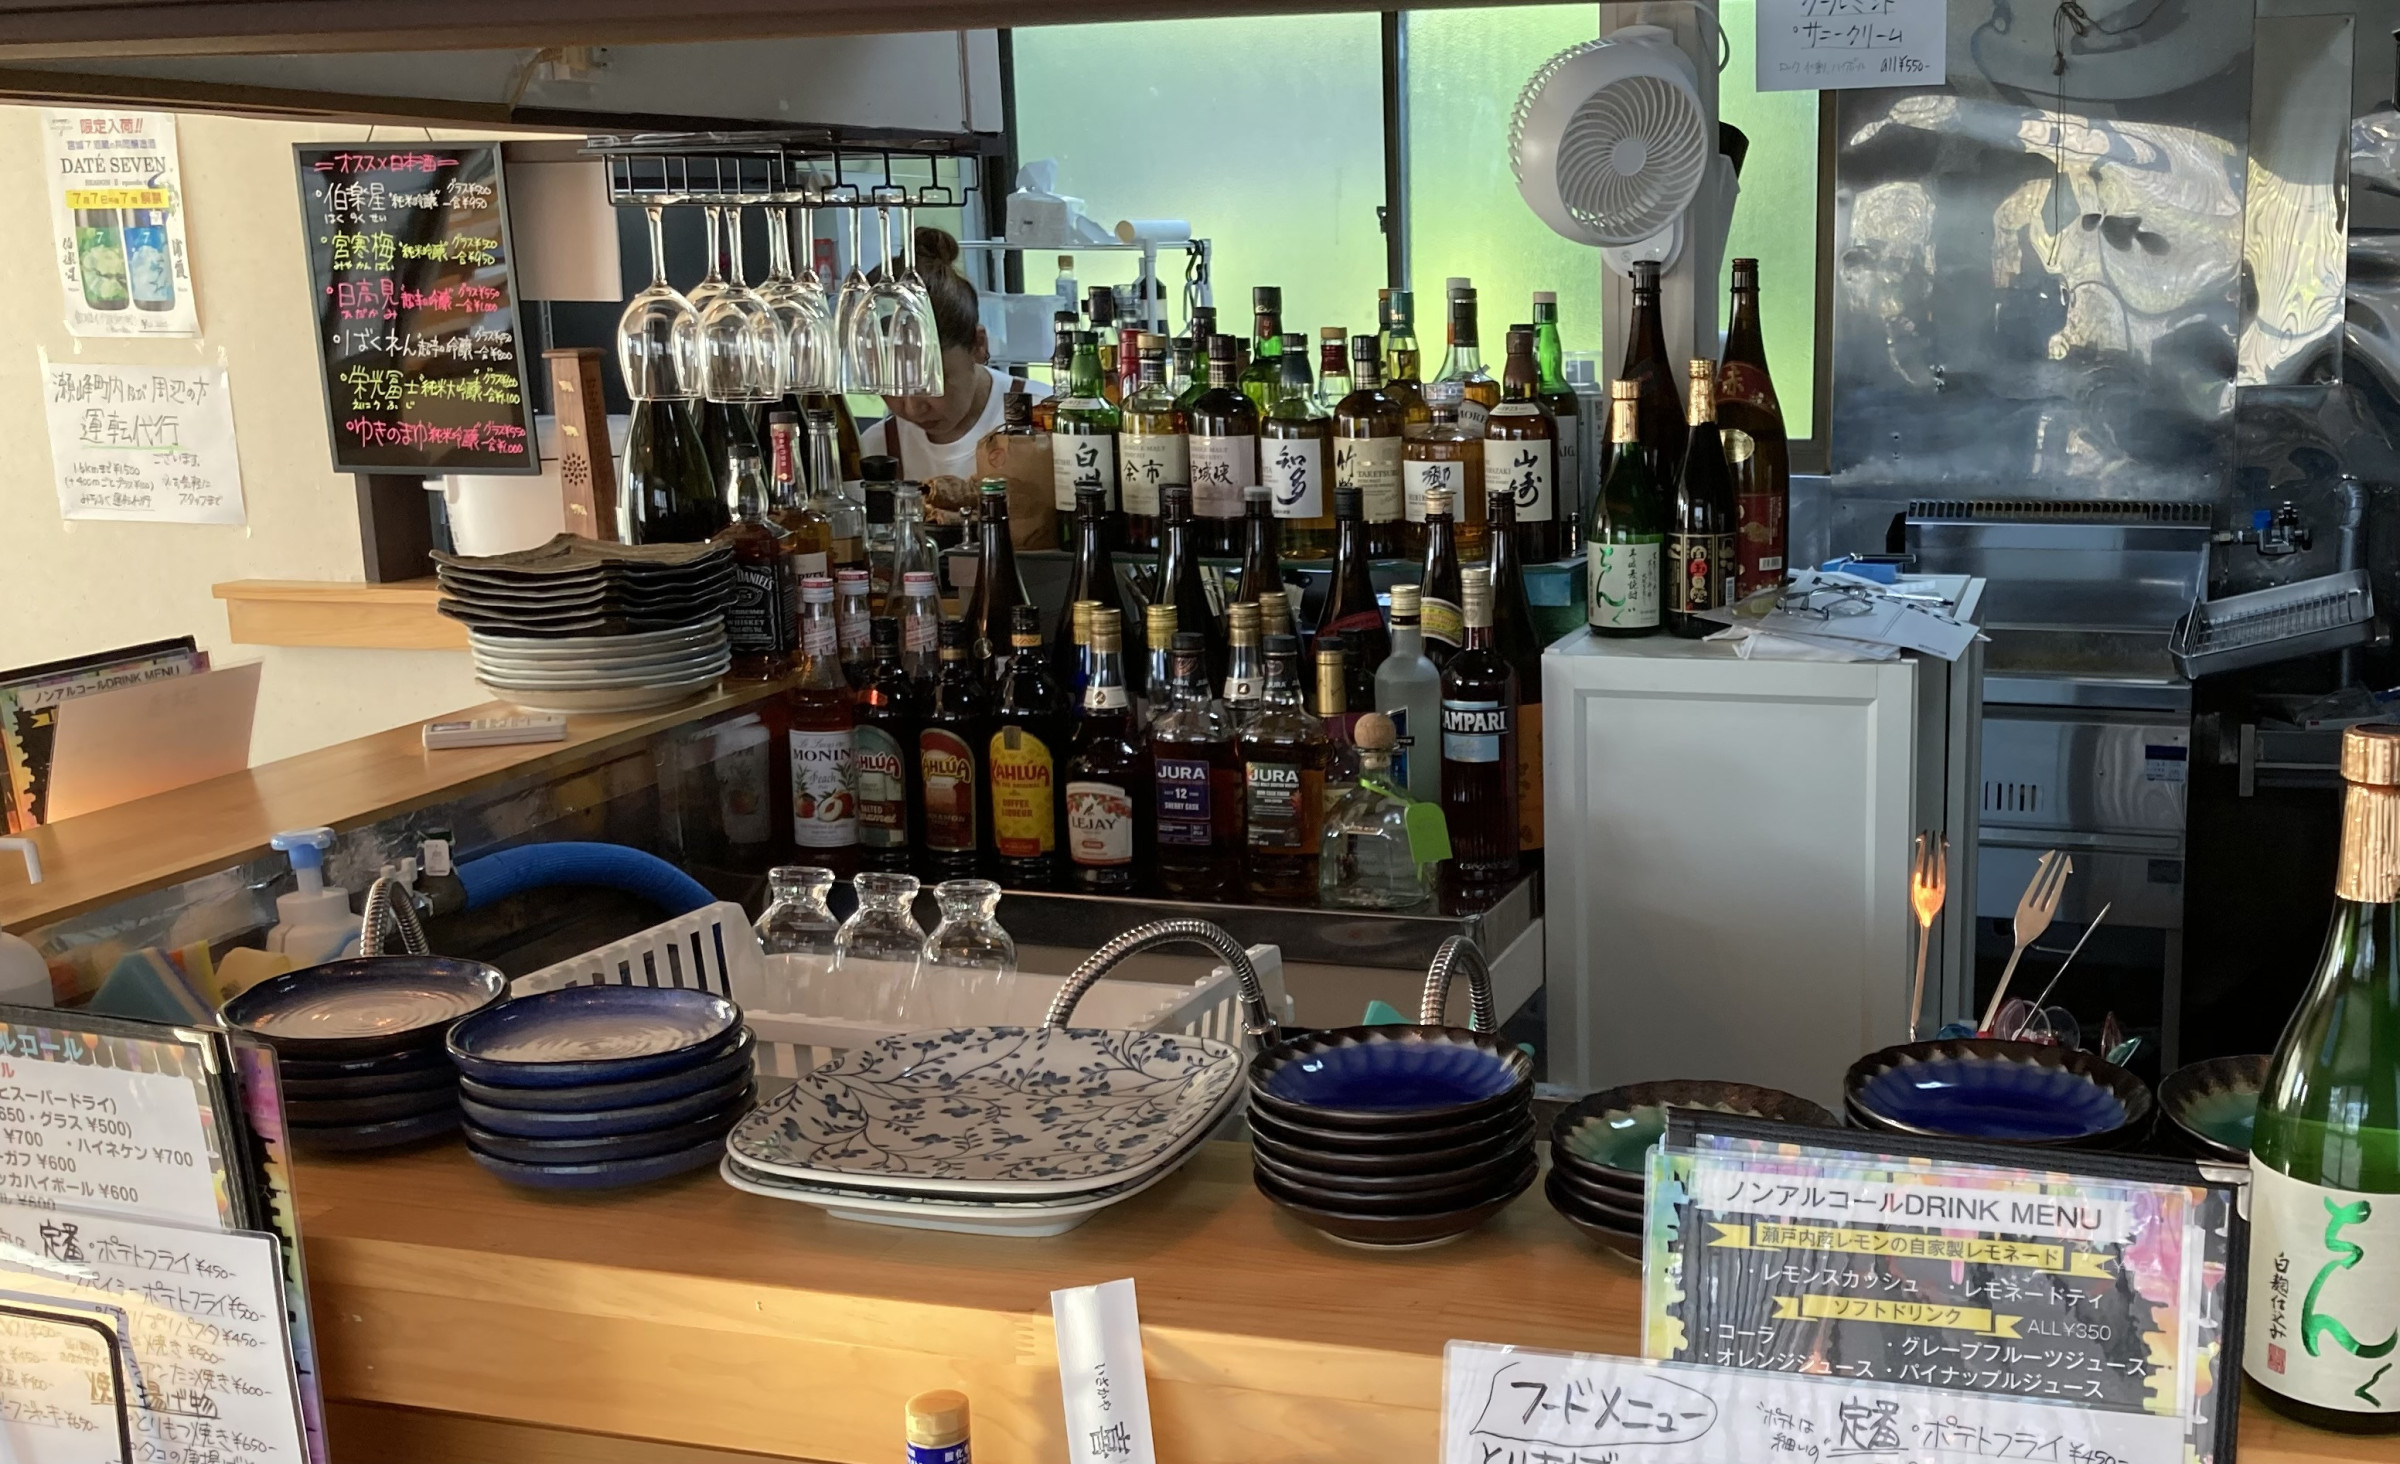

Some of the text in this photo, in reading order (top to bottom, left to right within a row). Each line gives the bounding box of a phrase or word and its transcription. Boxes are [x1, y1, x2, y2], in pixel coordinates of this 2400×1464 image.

[1802, 21, 1902, 48] サニークリーム
[79, 117, 144, 134] 限定入荷!!
[60, 154, 167, 174] DATÉ SEVEN
[96, 231, 104, 243] 7
[142, 231, 151, 243] 7
[332, 229, 396, 262] 宮寒梅
[338, 278, 399, 310] 日高見
[80, 409, 179, 446] 運転代行
[1123, 459, 1164, 485] 余市
[1275, 445, 1307, 506] 知多
[736, 568, 776, 591] DANIEL'S
[1442, 711, 1507, 732] AMPARI
[793, 748, 852, 762] MONIN
[809, 769, 837, 785] Peach
[990, 758, 1050, 787] KAHLÚA
[1157, 765, 1206, 780] JURA
[1249, 769, 1299, 783] JURA
[1175, 787, 1188, 800] 12
[1164, 801, 1200, 811] SHERRY CASK
[1072, 816, 1117, 830] LEJAY
[86, 1117, 132, 1138] ¥500)
[4, 1128, 193, 1167] ¥700 ハイネケン ¥700
[37, 1153, 76, 1173] ¥600
[99, 1183, 139, 1203] ¥600
[2011, 1202, 2102, 1230] MENU
[40, 1220, 85, 1263] 定番
[1761, 1225, 2059, 1266] 瀬戸内産レモンの自家製レモネード
[1764, 1264, 2104, 1309] レモンスカッシュ レモネードティ
[1834, 1299, 1962, 1325] ソフトドリンク
[1718, 1323, 1775, 1345] コーラ
[2027, 1319, 2112, 1342] ALL¥350
[1901, 1336, 2148, 1377] グレープフルーツジュース
[1717, 1348, 2104, 1399] オレンジジュース パイナップルジュース
[1509, 1376, 1708, 1432] フードメニュー
[1838, 1395, 1901, 1450] 定番
[1922, 1415, 2066, 1463] ポテトフライ
